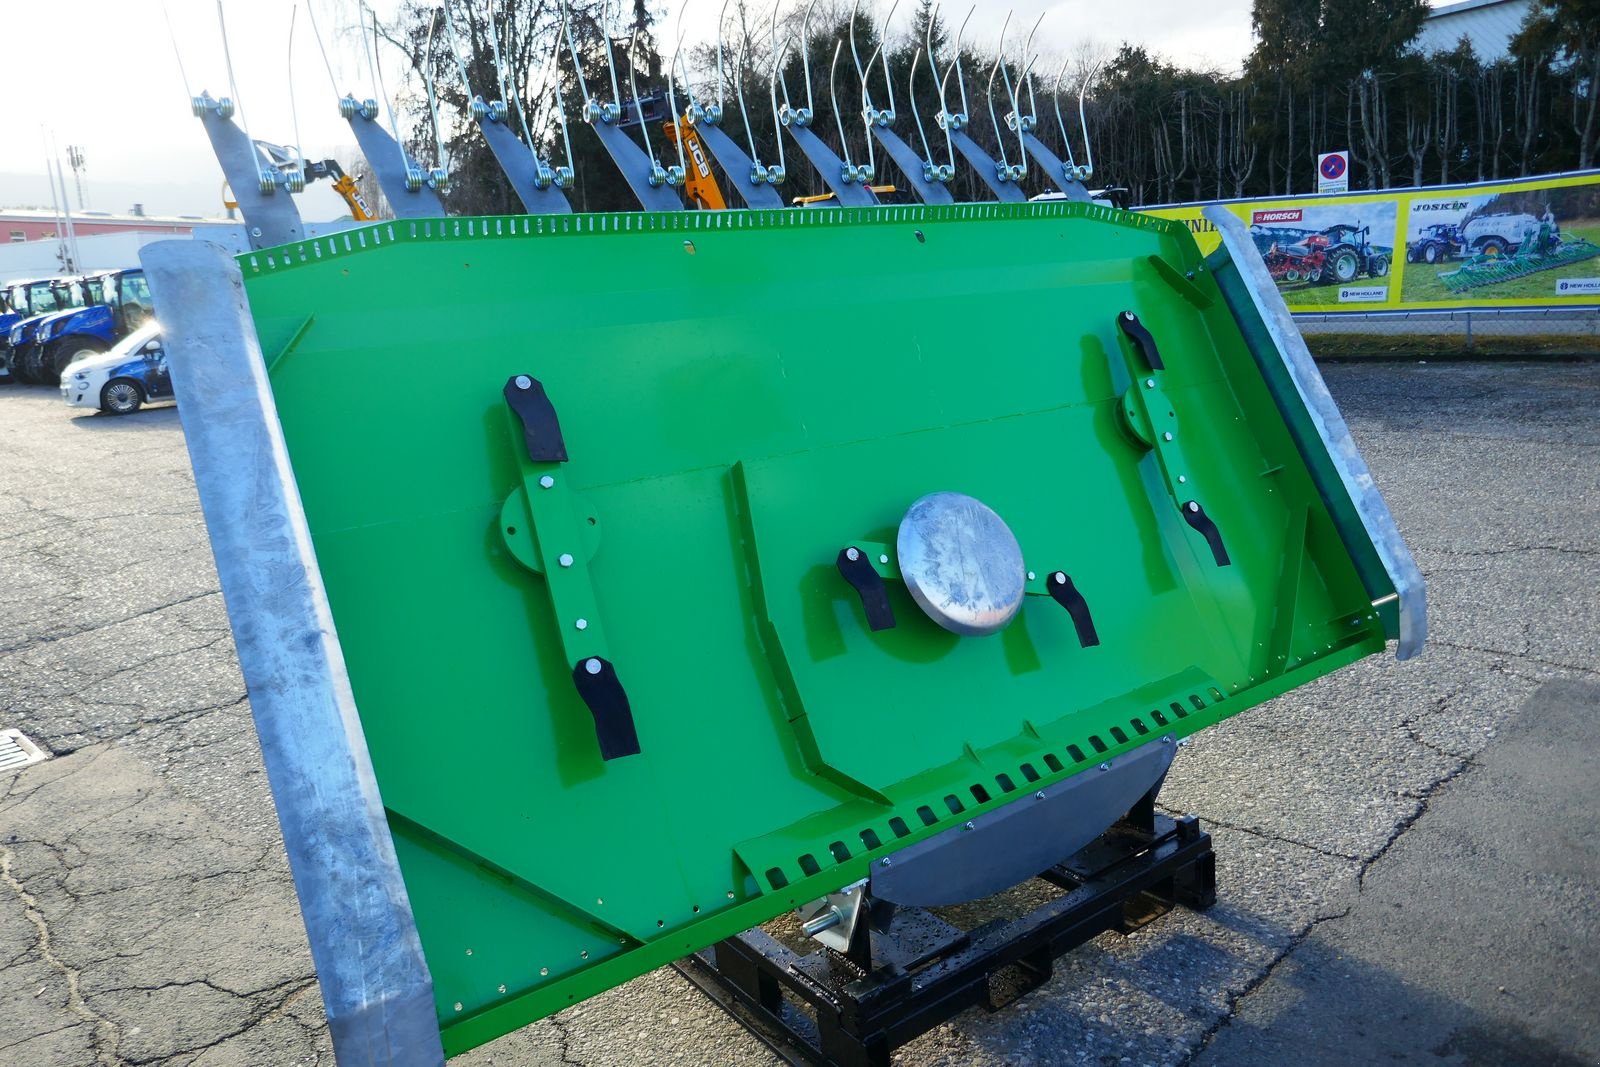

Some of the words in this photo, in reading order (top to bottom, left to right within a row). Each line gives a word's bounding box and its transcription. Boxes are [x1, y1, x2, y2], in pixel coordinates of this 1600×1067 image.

[688, 139, 709, 178] JCB
[352, 192, 373, 218] JCB
[1263, 212, 1300, 221] HORSCH
